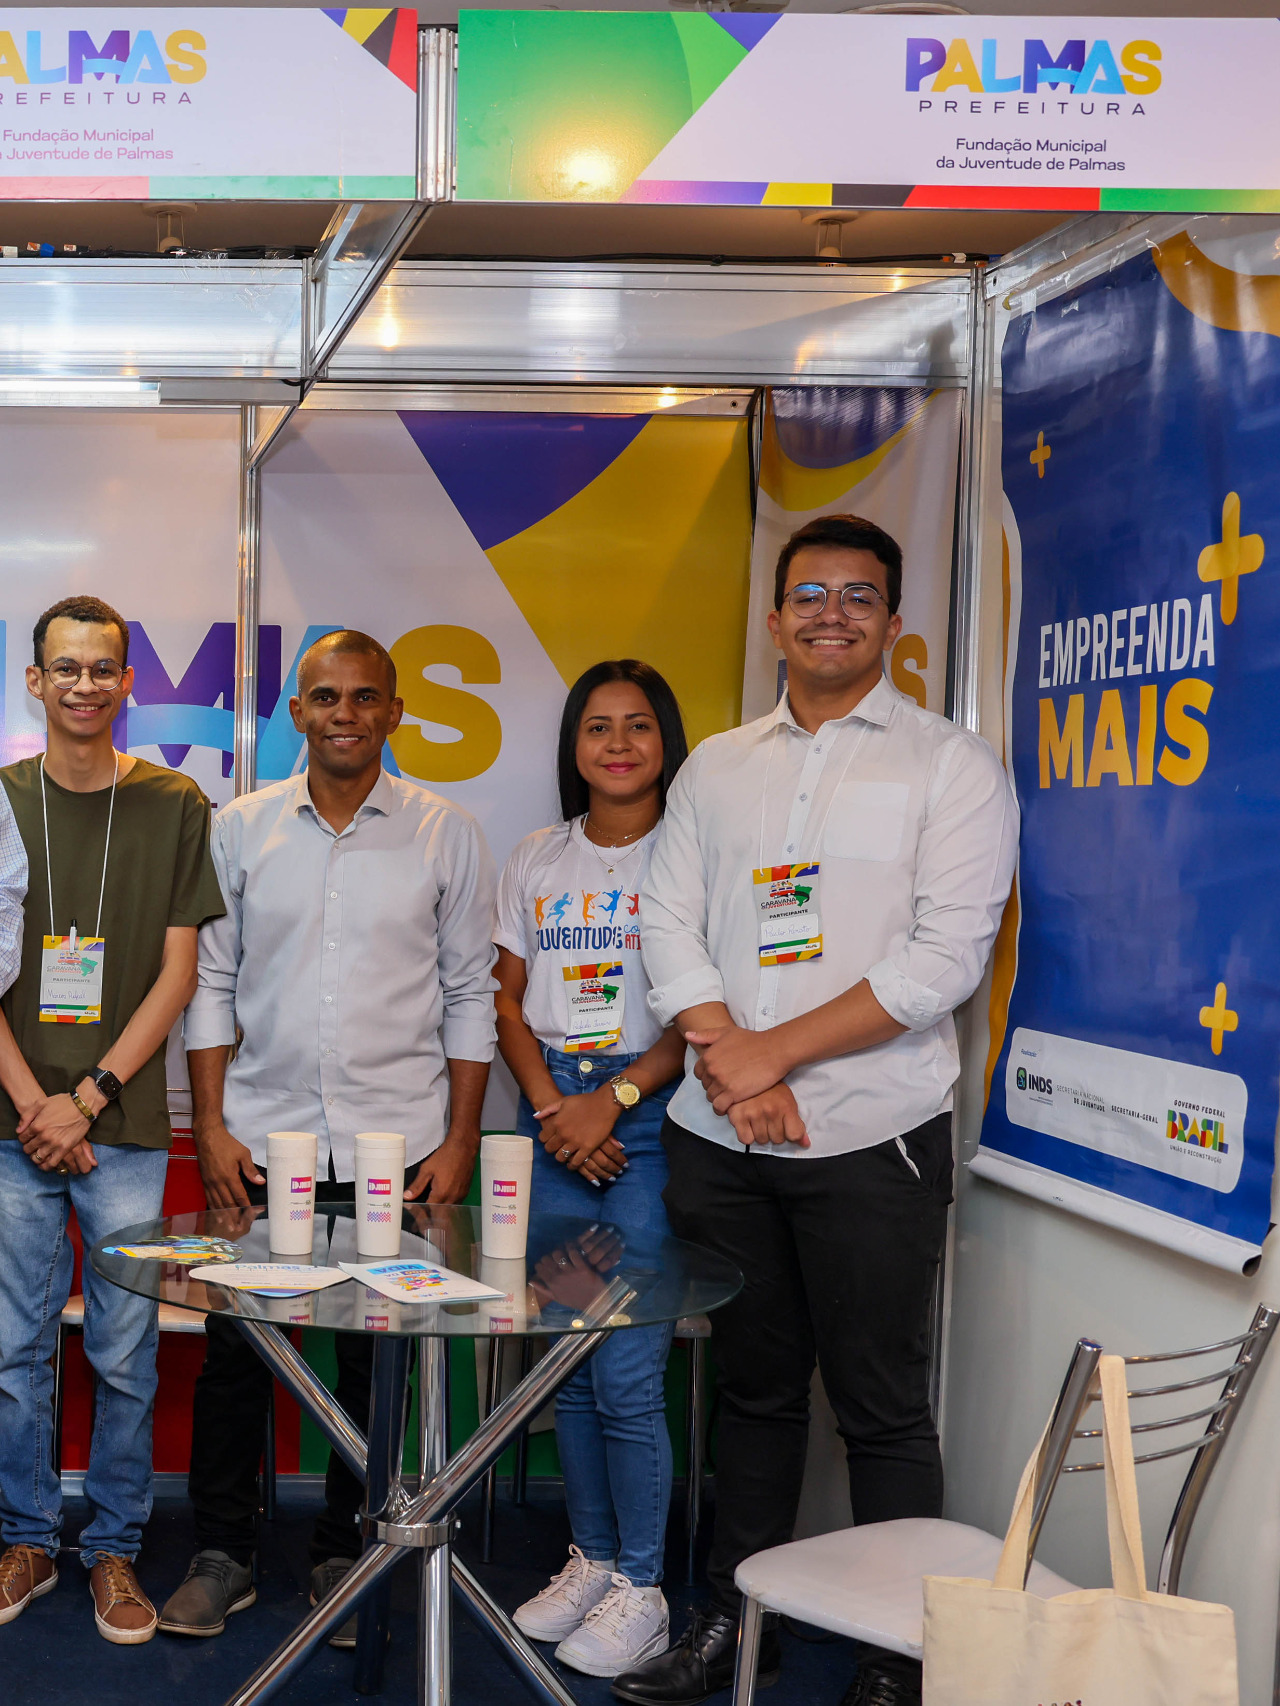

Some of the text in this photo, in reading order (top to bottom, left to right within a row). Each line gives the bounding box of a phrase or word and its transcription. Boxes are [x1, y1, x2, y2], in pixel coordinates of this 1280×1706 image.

[906, 38, 1162, 95] PALMAS
[919, 100, 1146, 115] PREFEITURA
[3, 128, 154, 146] Fundação Municipal
[956, 137, 1107, 155] Fundação Municipal
[7, 147, 90, 160] Juventude
[95, 147, 112, 160] de
[118, 147, 174, 160] Palmas
[936, 156, 1126, 171] da Juventude de Palmas
[1039, 593, 1215, 689] EMPREENDA
[1038, 677, 1214, 789] MAIS
[761, 897, 797, 907] CARAVANA
[769, 909, 809, 919] PARTICIPANTE
[535, 925, 624, 951] JUVENTUDE
[1028, 1073, 1053, 1095] INDS
[1056, 1084, 1105, 1104] SECRETARIA NACIONAL
[1080, 1099, 1105, 1113] JUVENTUDE
[1111, 1104, 1159, 1124] SECRETARIA-GERAL
[1173, 1099, 1226, 1119] GOVERNO FEDERAL
[1165, 1109, 1229, 1155] BRASIL
